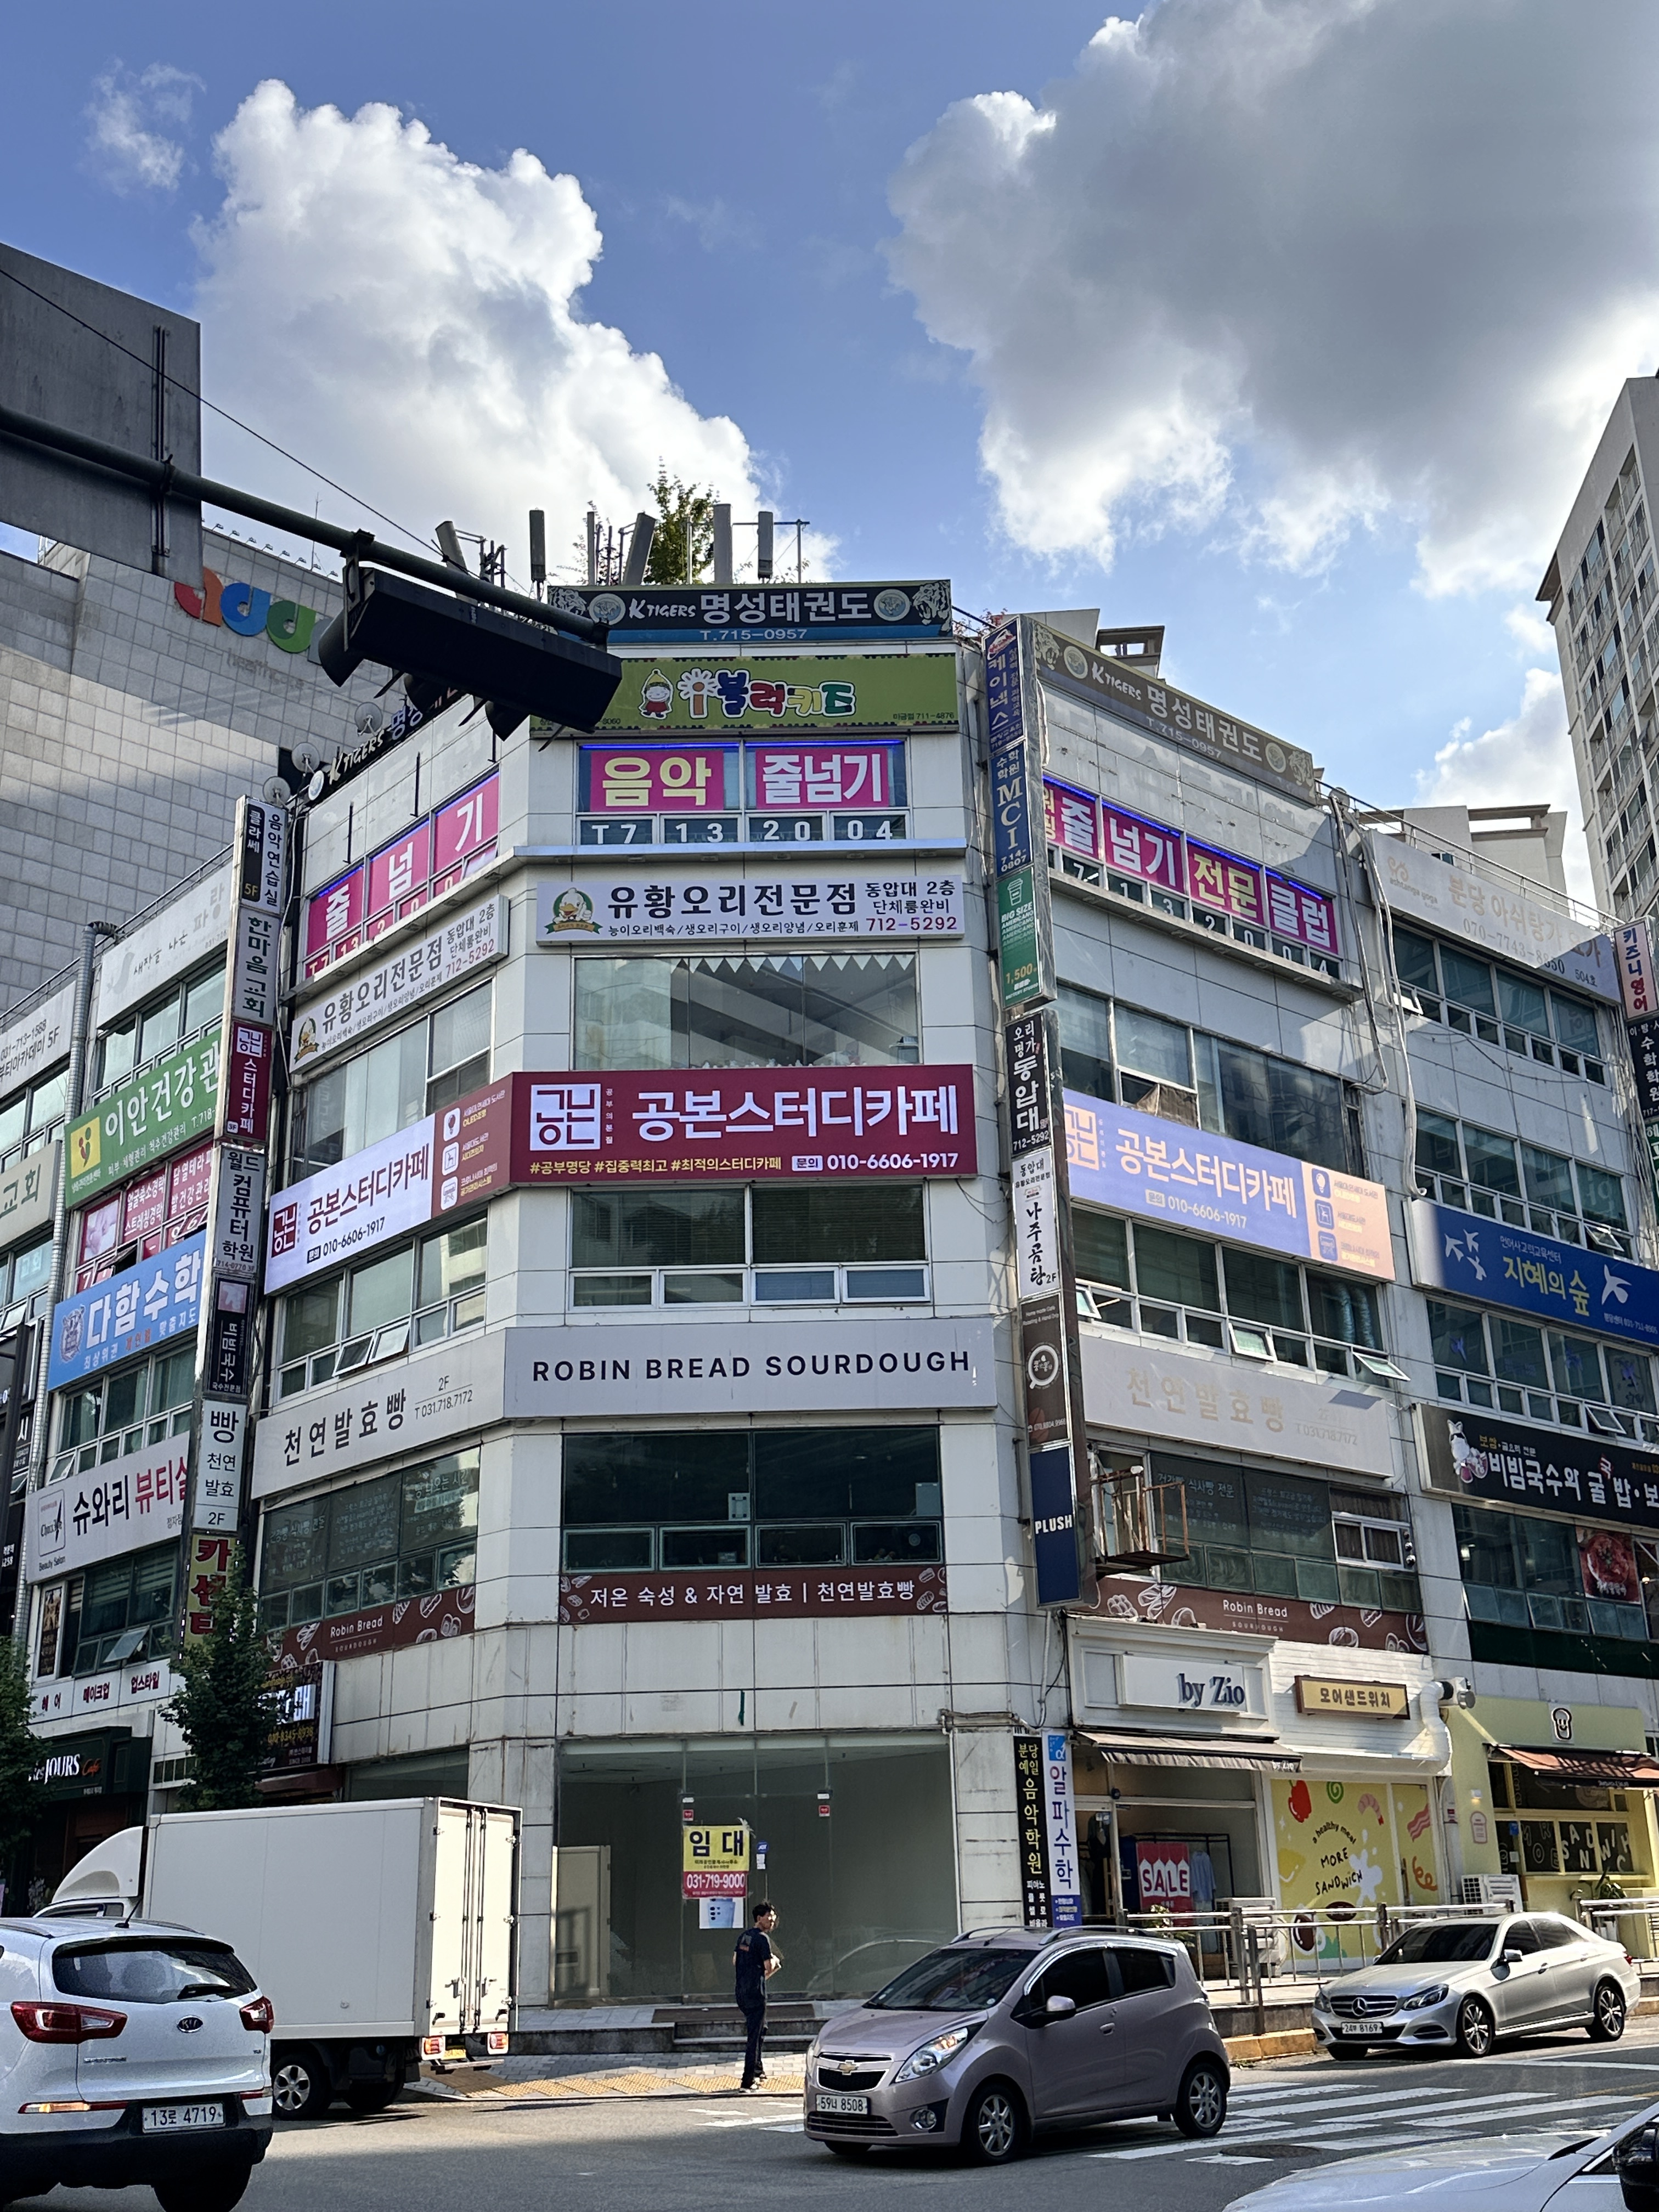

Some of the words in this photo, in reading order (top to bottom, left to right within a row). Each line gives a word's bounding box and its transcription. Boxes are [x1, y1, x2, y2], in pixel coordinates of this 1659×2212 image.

[700, 592, 872, 625] 명성태권도
[699, 629, 807, 641] T.715-0957
[1147, 684, 1263, 761] 명성태권도
[602, 757, 712, 807] 음악
[762, 754, 883, 804] 줄넘기
[996, 775, 1024, 850] MCI
[1061, 797, 1175, 887] 줄넘기
[1194, 853, 1257, 918] 전문
[1271, 882, 1330, 949] 클럽
[244, 883, 258, 896] 5F
[608, 883, 856, 919] 유황오리전문점
[865, 882, 917, 898] 동압대
[927, 879, 956, 896] 2층
[873, 899, 949, 915] 단체룸완비
[1001, 909, 1015, 923] BIG
[1016, 901, 1033, 917] SIZE
[866, 917, 957, 932] 712-5292
[242, 916, 272, 1018] 한마음교회
[445, 938, 495, 979] 712-5292
[322, 936, 442, 1035] 유황오리전문점
[48, 1025, 60, 1048] 5F
[1014, 1020, 1035, 1041] 오리
[240, 1058, 257, 1135] 스터디카페
[1014, 1055, 1040, 1132] 동압대
[633, 1085, 959, 1142] 공본스터디카페
[1013, 1131, 1049, 1151] 712-5292
[227, 1152, 260, 1173] 월드
[529, 1160, 591, 1175] #공부명당
[594, 1158, 668, 1174] #집중력최고
[671, 1156, 782, 1173] #최적의스터디카페
[796, 1157, 820, 1170] 문의
[827, 1153, 959, 1171] 010-6606-1917
[1116, 1128, 1297, 1218] 공본스터디카페
[307, 1143, 430, 1235] 공본스터디카페
[230, 1174, 252, 1243] 컴퓨터
[1168, 1194, 1247, 1229] 010-6606-1917
[222, 1240, 253, 1263] 학원
[323, 1217, 386, 1257] 010-6606-1917
[1026, 1201, 1046, 1286] 나주곰탕
[1046, 1272, 1057, 1284] 2F
[85, 1249, 202, 1349] 다함수학
[1503, 1256, 1567, 1301] 지혜의
[1569, 1269, 1590, 1317] 숲
[533, 1359, 631, 1382] ROBIN
[646, 1356, 751, 1380] BREAD
[766, 1351, 970, 1377] SOURDOUGH
[438, 1376, 450, 1391] 2F
[421, 1390, 473, 1418] 031.718.7172
[1127, 1366, 1285, 1434] 천연발효빵
[210, 1410, 239, 1444] 빵
[284, 1389, 407, 1466] 천연발효빵
[206, 1452, 236, 1472] 천연
[205, 1479, 234, 1498] 발효
[1488, 1452, 1582, 1502] 비빔국수와
[73, 1475, 130, 1536] 슈와리
[208, 1512, 225, 1525] 2F
[1035, 1515, 1073, 1534] PLUSH
[590, 1586, 629, 1609] 저온
[638, 1585, 675, 1607] 숙성
[685, 1587, 698, 1605] &
[706, 1583, 744, 1605] 자연
[755, 1582, 793, 1603] 발효
[817, 1579, 916, 1602] 천연발효빵
[1223, 1599, 1254, 1615] Robin
[1256, 1602, 1289, 1618] Bread
[330, 1621, 355, 1639] Robin
[357, 1615, 383, 1634] Bread
[1178, 1673, 1206, 1708] by
[1211, 1676, 1245, 1706] Zio
[1320, 1686, 1391, 1708] 모어샌드위치
[1018, 1743, 1038, 1759] 분당
[44, 1753, 81, 1785] JOURS
[1018, 1759, 1040, 1776] 예일
[1023, 1777, 1042, 1875] 음악학원
[1049, 1765, 1074, 1890] 알파수학
[1316, 1821, 1339, 1837] healthy
[1340, 1826, 1357, 1845] meal
[689, 1830, 744, 1857] 임대
[1321, 1847, 1349, 1869] MORE
[687, 1874, 746, 1889] 031-719-9000
[1142, 1869, 1188, 1893] SALE
[1359, 2023, 1379, 2033] 8169
[151, 2109, 177, 2128] 13로
[183, 2106, 217, 2124] 4719
[841, 2098, 864, 2112] 8508
